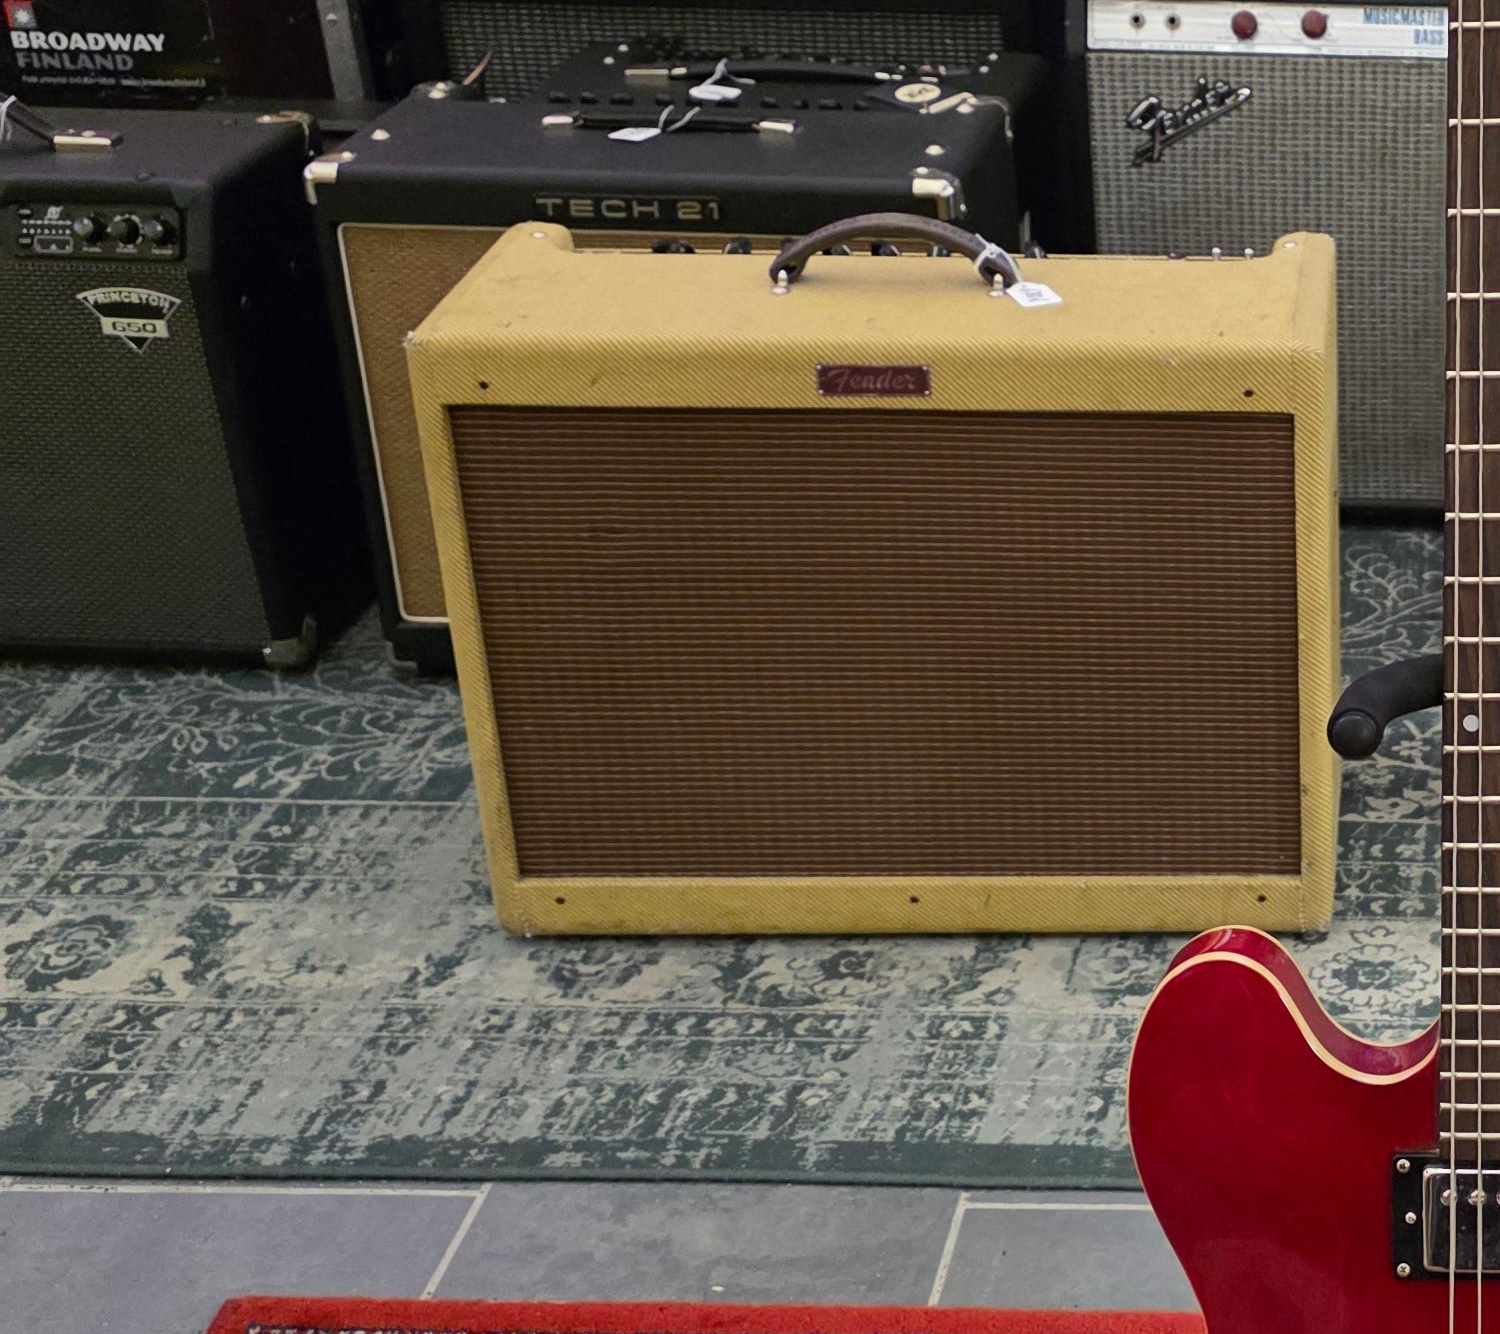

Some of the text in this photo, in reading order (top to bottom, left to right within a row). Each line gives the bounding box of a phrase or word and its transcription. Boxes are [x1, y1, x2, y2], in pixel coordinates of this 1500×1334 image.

[1362, 7, 1445, 26] MUSICMASTER
[9, 30, 166, 52] BROADWAY
[15, 51, 135, 72] FINLAND
[535, 197, 720, 221] TECH 21
[87, 289, 172, 316] PRINCETON
[111, 320, 158, 334] 650
